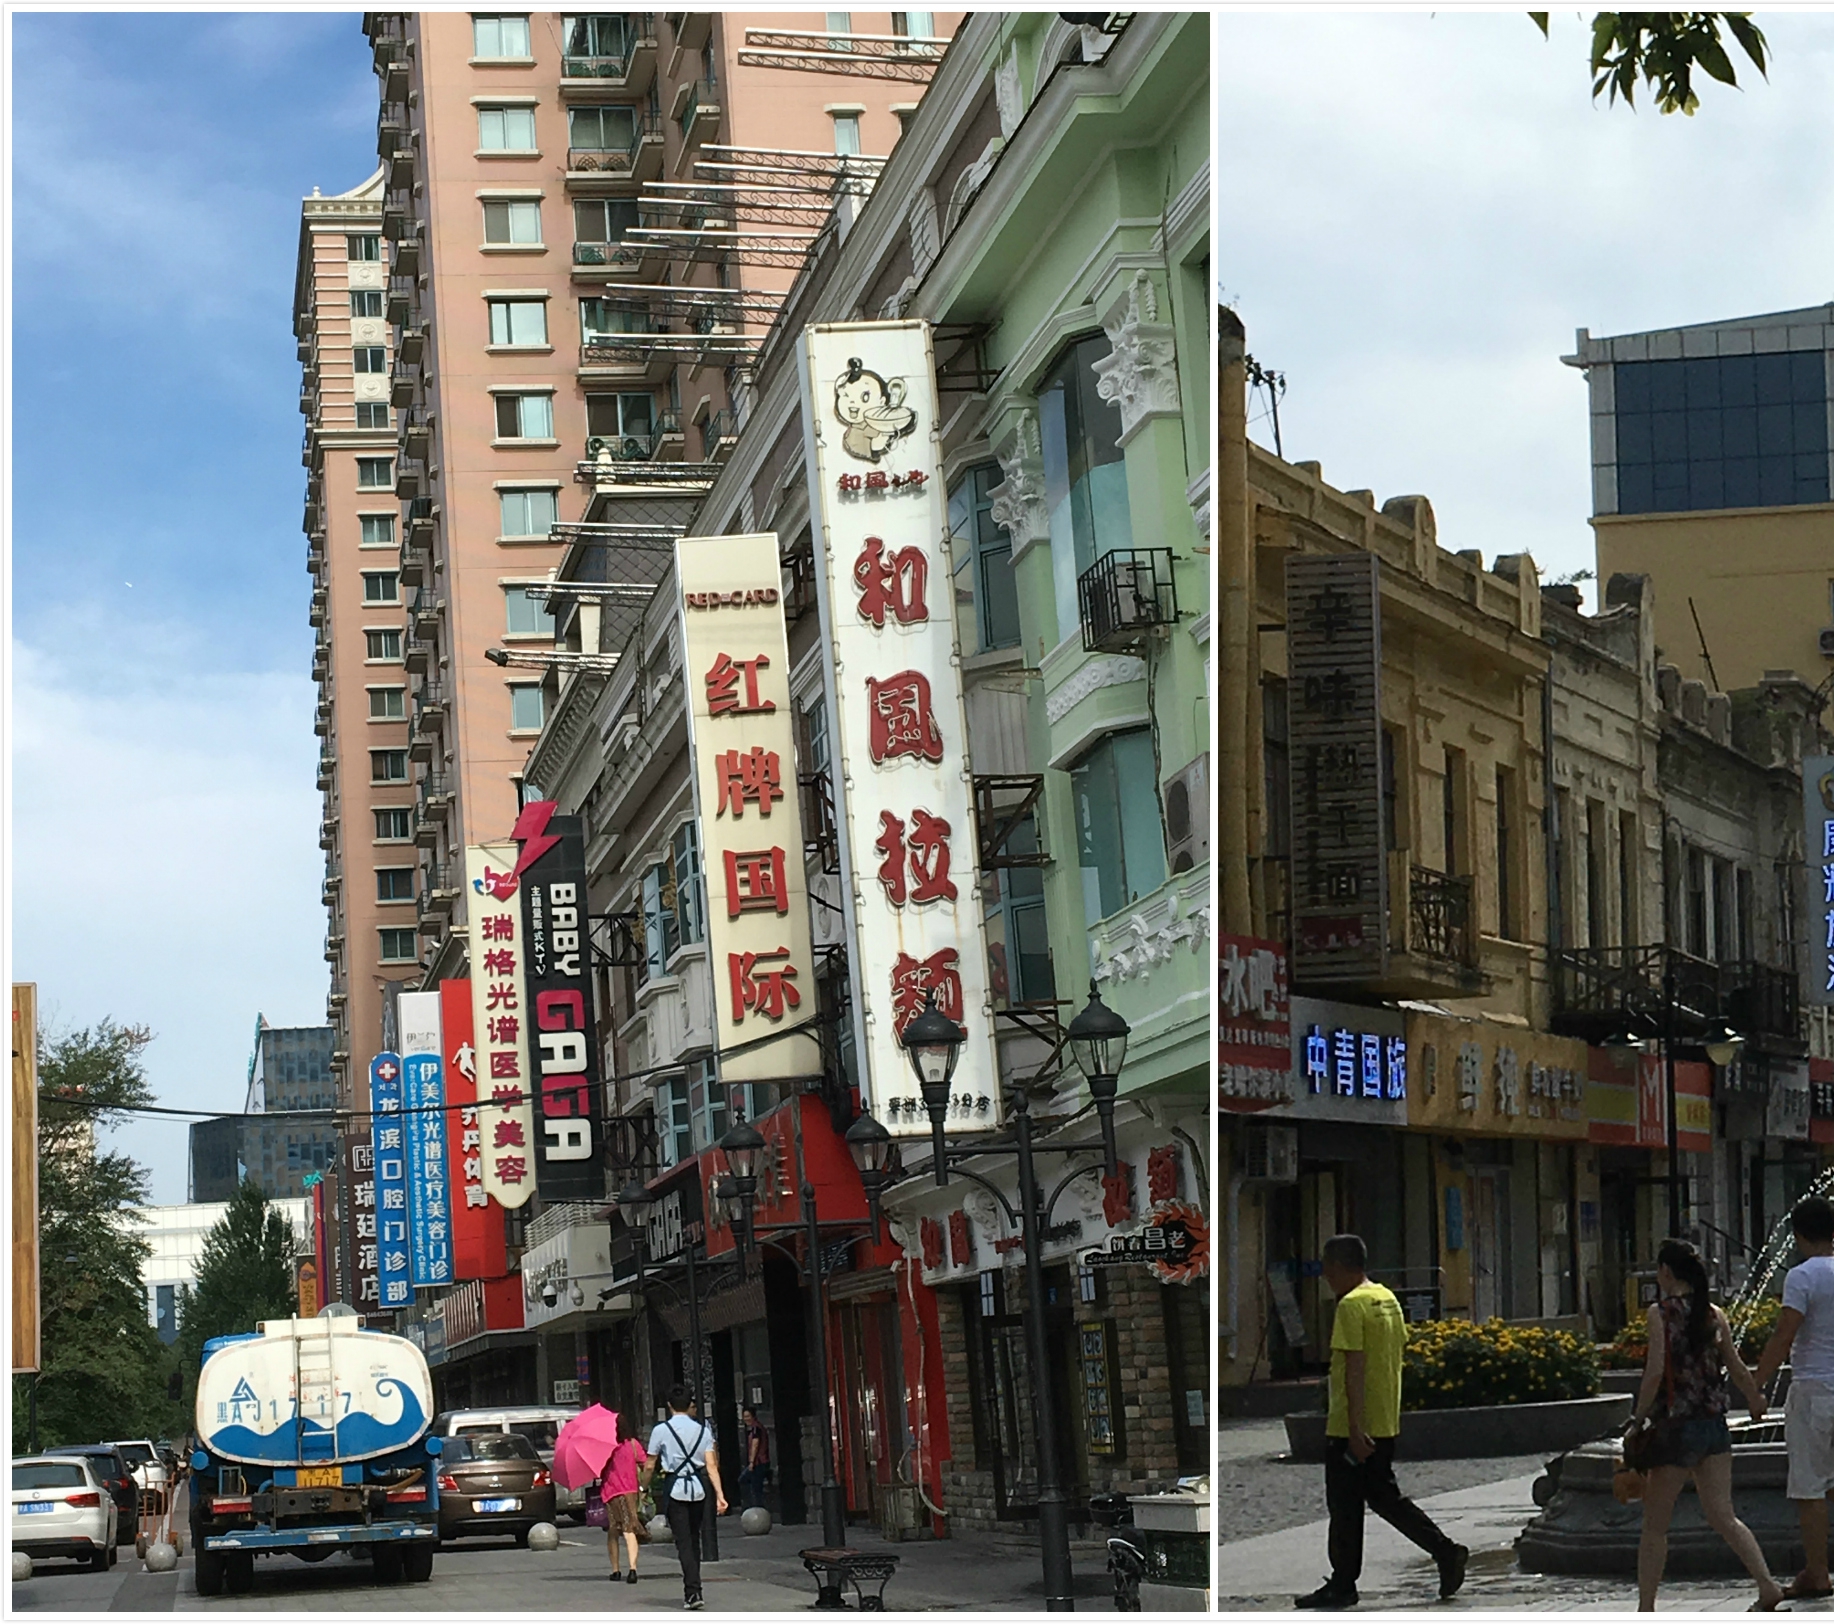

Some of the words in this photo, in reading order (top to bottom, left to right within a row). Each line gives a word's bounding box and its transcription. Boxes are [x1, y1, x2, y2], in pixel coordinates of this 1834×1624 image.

[550, 882, 581, 976] BABY
[705, 652, 801, 1021] 红牌国际
[481, 913, 528, 1185] 瑞格光谱医学美容
[536, 989, 592, 1161] GAGA
[378, 1097, 409, 1302] 龙滨口腔门诊部
[420, 1062, 449, 1280] 伊美尔光谱医疗美容门诊
